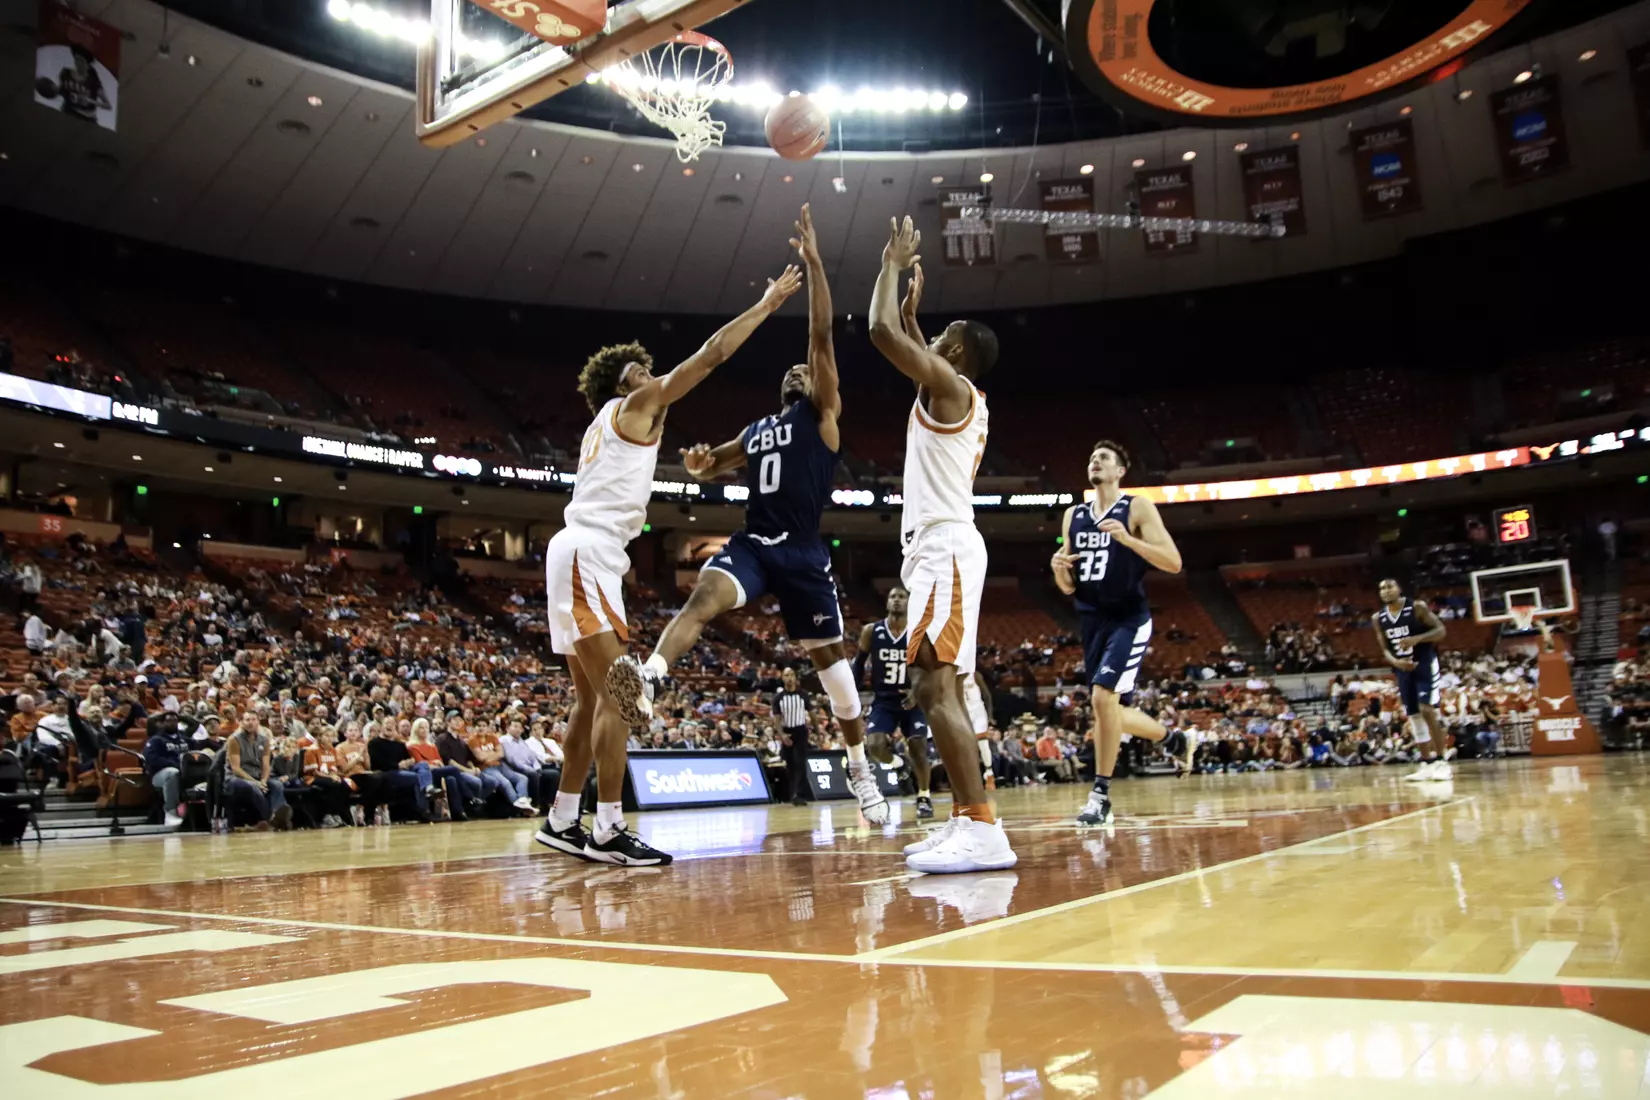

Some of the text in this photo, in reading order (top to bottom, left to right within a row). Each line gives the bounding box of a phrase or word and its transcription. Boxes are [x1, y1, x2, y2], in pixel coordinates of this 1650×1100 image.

[1050, 183, 1083, 196] TEXAS
[747, 423, 792, 454] CBU
[759, 452, 781, 494] 0
[1075, 531, 1111, 549] CBU
[1079, 549, 1109, 582] 33
[883, 662, 907, 685] 31
[1538, 716, 1583, 732] MUSCLE
[645, 767, 741, 795] Southwest
